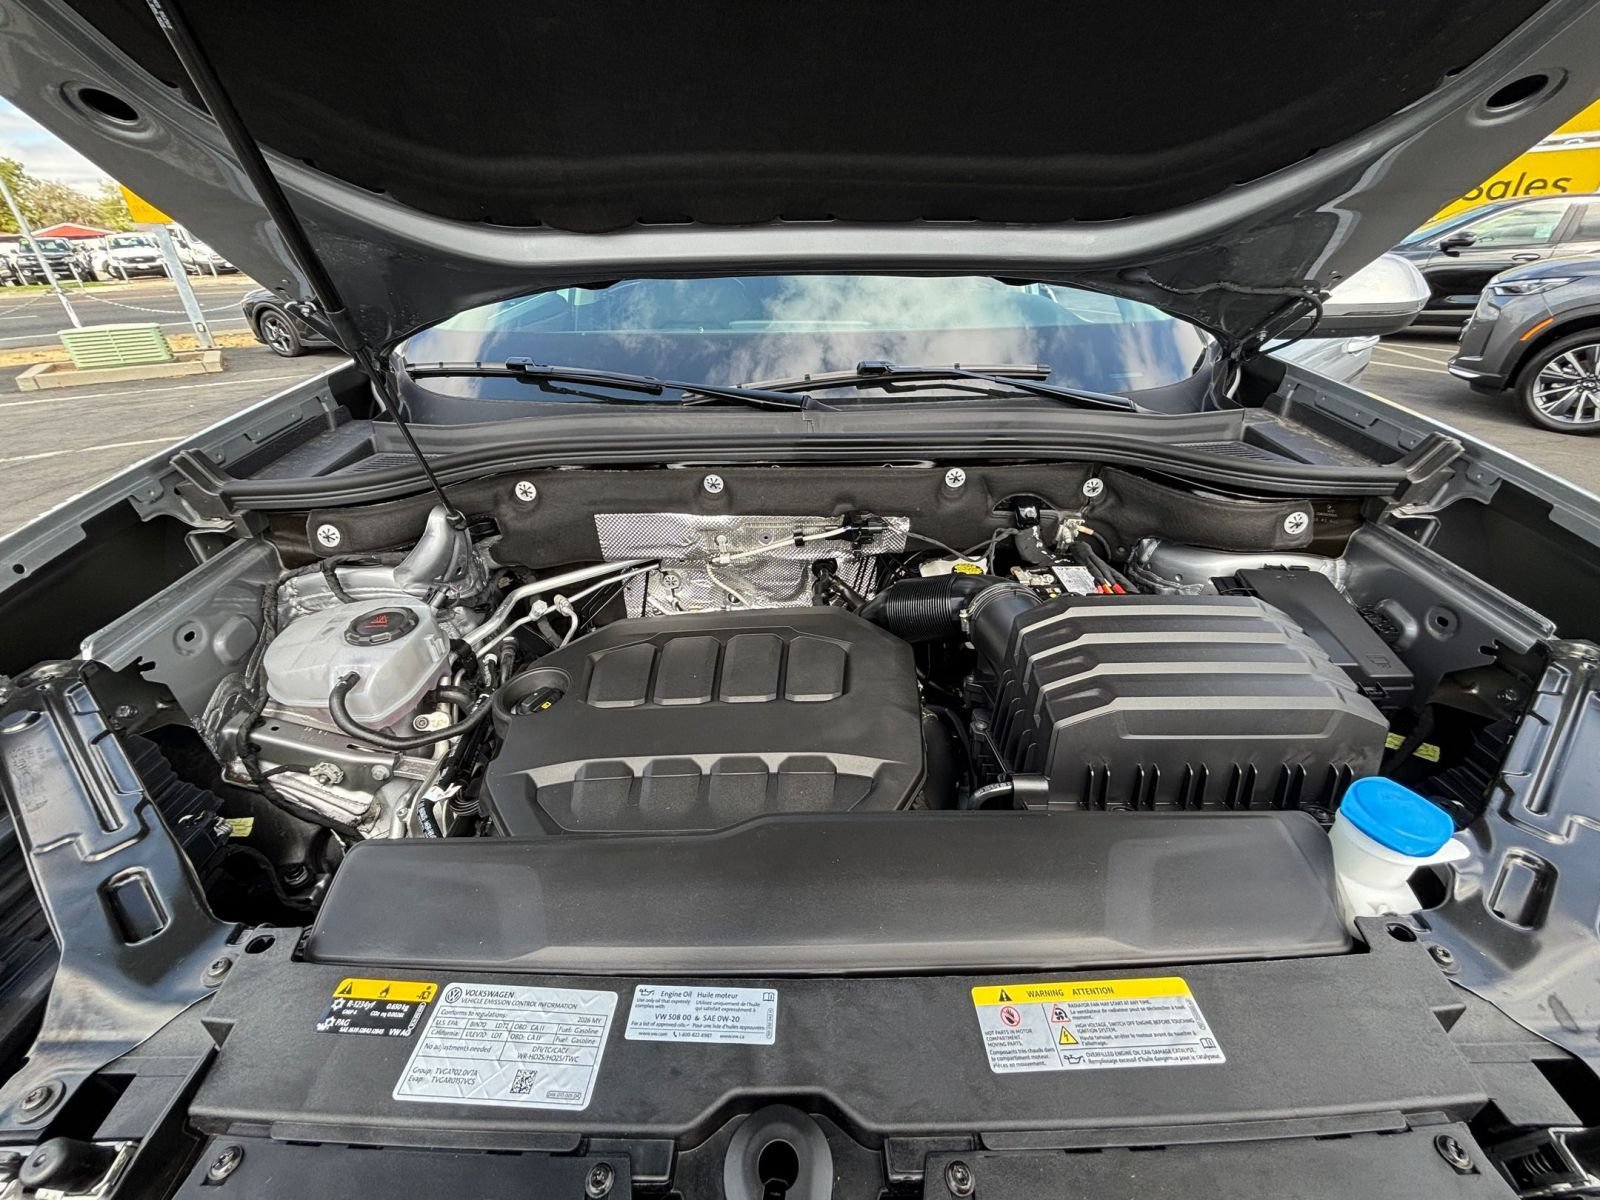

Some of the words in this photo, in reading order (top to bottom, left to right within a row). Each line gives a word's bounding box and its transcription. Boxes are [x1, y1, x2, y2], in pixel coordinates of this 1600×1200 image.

[465, 990, 515, 998] VOLKSWAGEN
[660, 991, 682, 999] Engine
[697, 991, 714, 999] Huile
[1026, 989, 1064, 998] WARNING
[1072, 986, 1115, 996] ATTENTION
[346, 1000, 377, 1010] R-1234yf
[537, 1001, 578, 1009] INFORMATION
[335, 1019, 351, 1027] PAG
